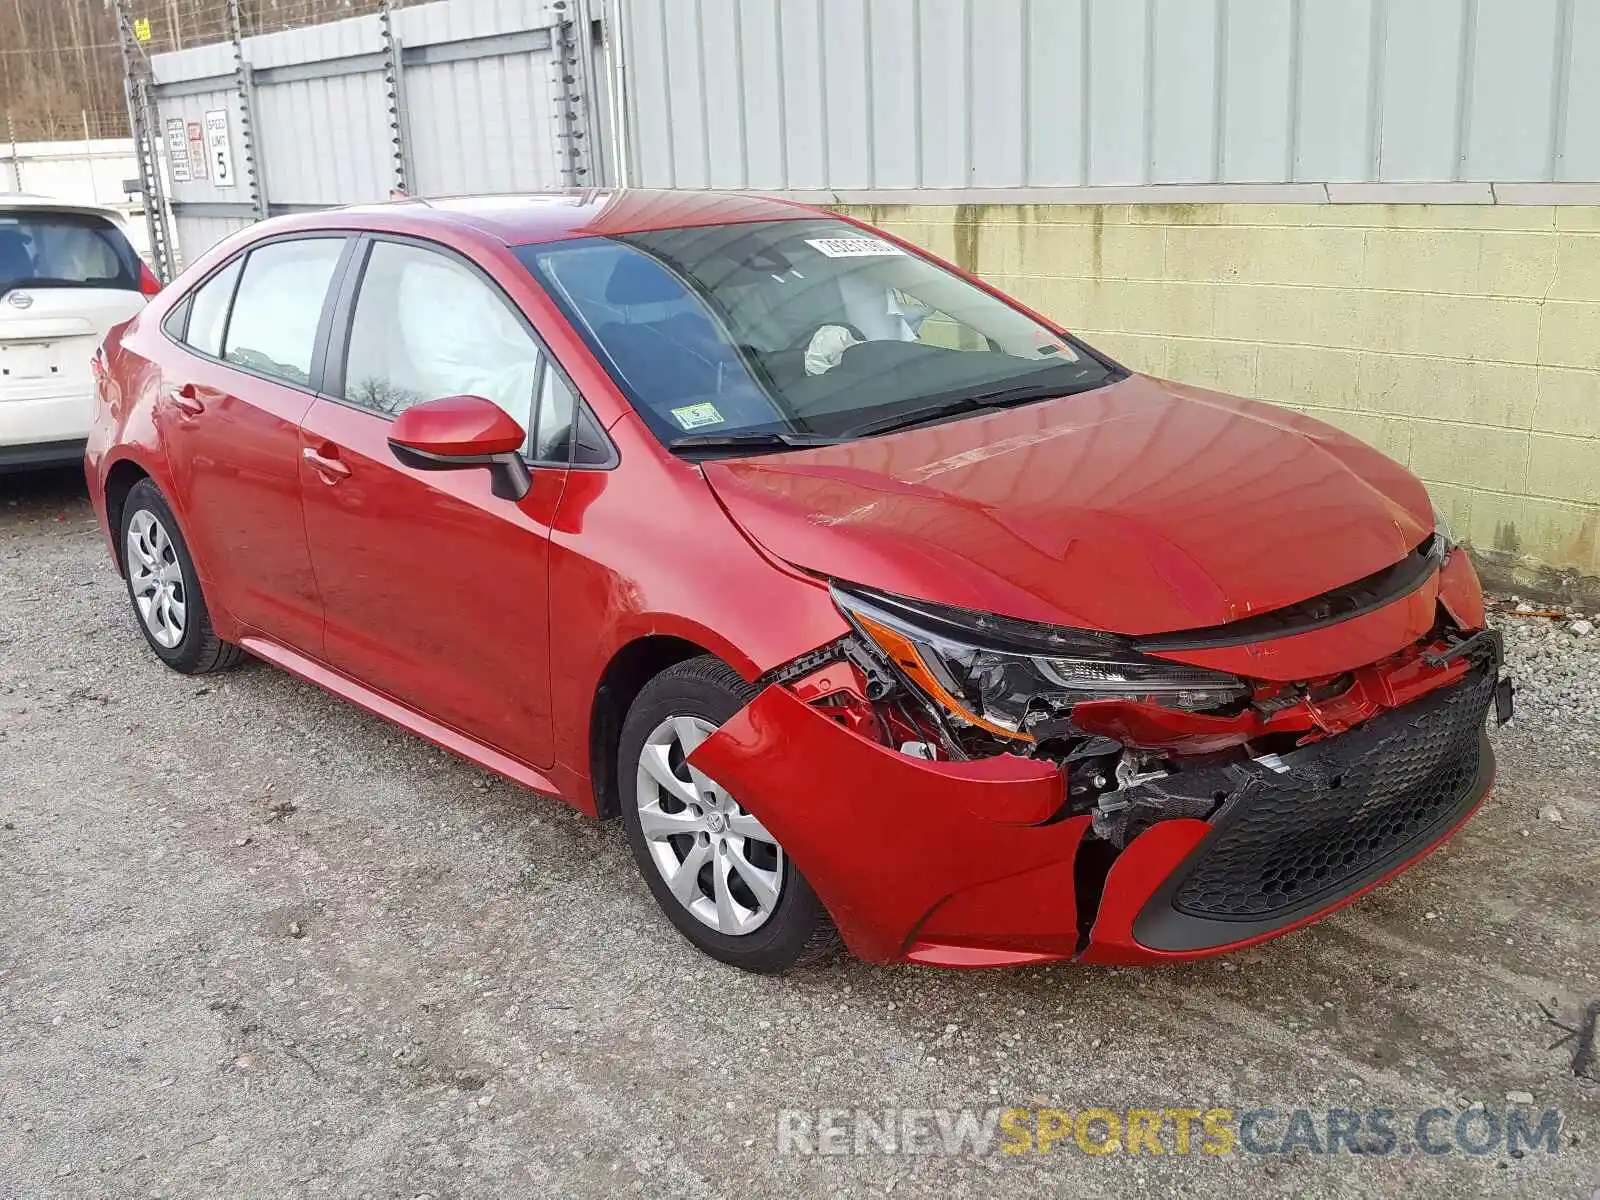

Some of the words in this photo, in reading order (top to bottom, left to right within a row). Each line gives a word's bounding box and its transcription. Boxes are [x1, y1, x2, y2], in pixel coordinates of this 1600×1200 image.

[208, 118, 225, 129] SPEED
[212, 135, 226, 147] LIMIT
[217, 152, 227, 178] 5
